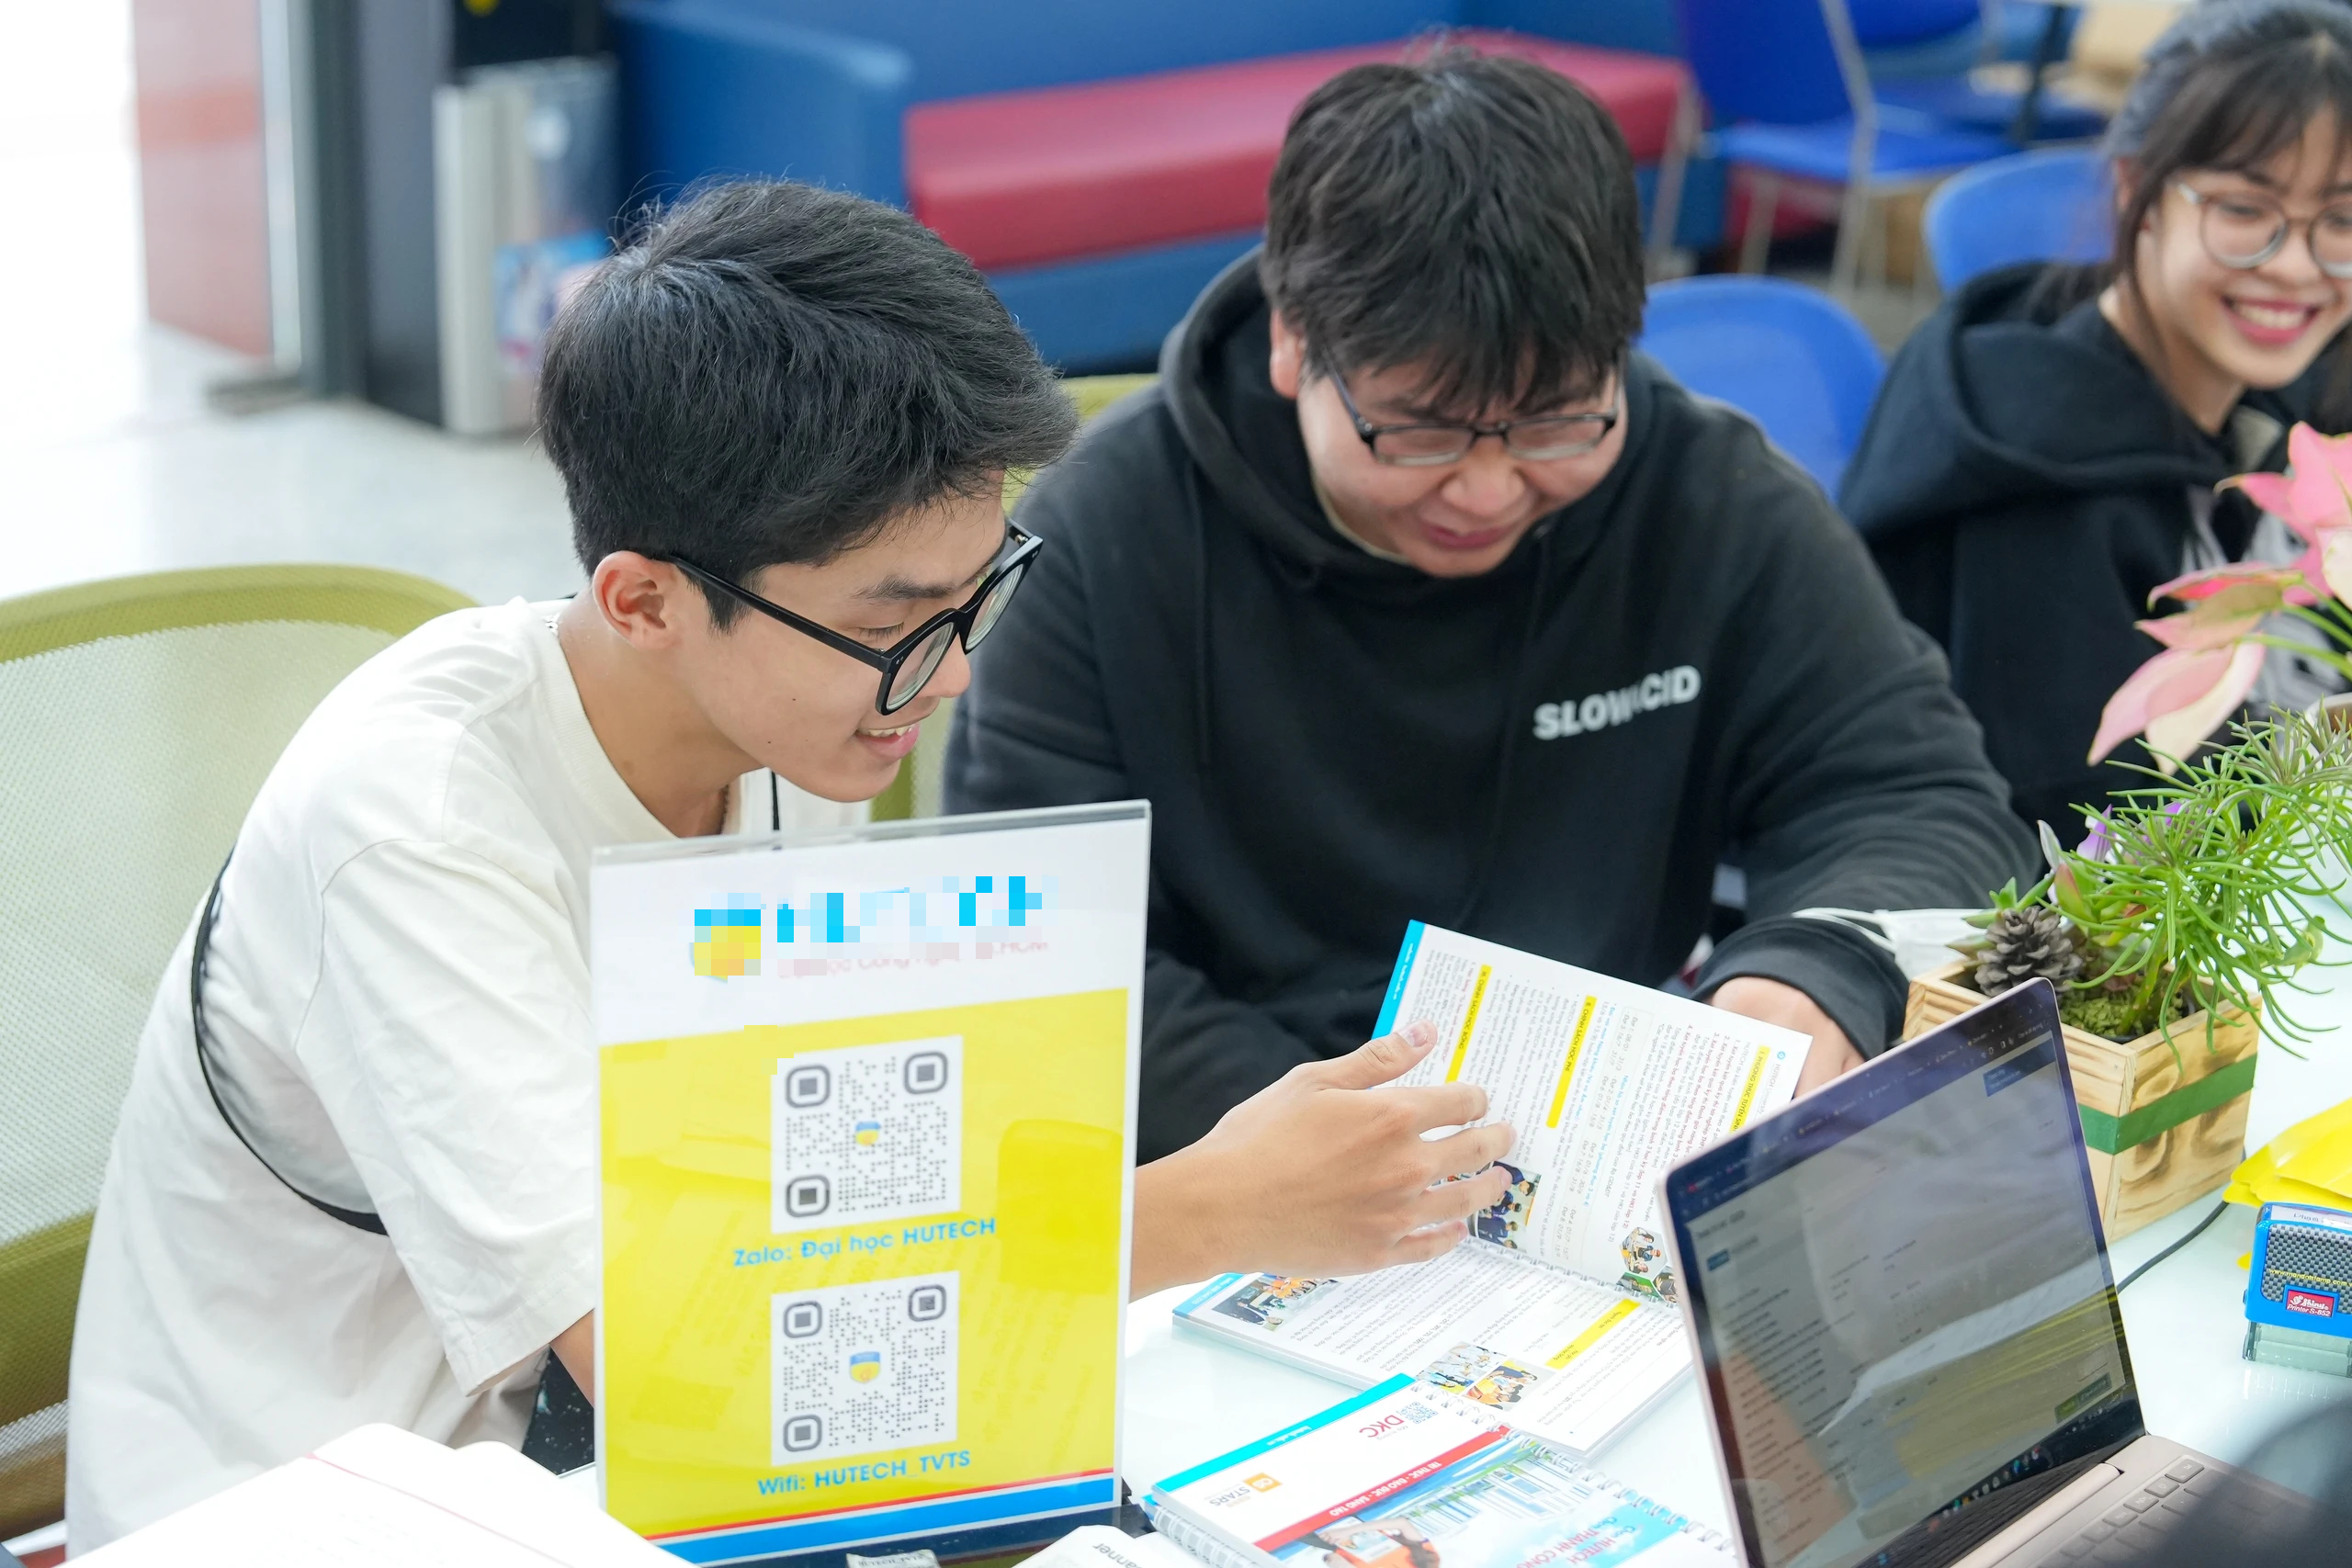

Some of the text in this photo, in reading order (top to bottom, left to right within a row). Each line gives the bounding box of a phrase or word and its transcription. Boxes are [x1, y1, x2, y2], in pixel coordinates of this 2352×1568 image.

[1532, 665, 1702, 740] SLOWCID
[733, 1217, 997, 1267] Zalo: Đại học HUTECH
[2287, 1303, 2310, 1313] Printer
[1359, 1415, 1405, 1438] DKC
[757, 1450, 971, 1495] Wifi: HUTECH_TVTS
[1209, 1486, 1250, 1506] STARS
[1566, 1537, 1616, 1564] HUTECH
